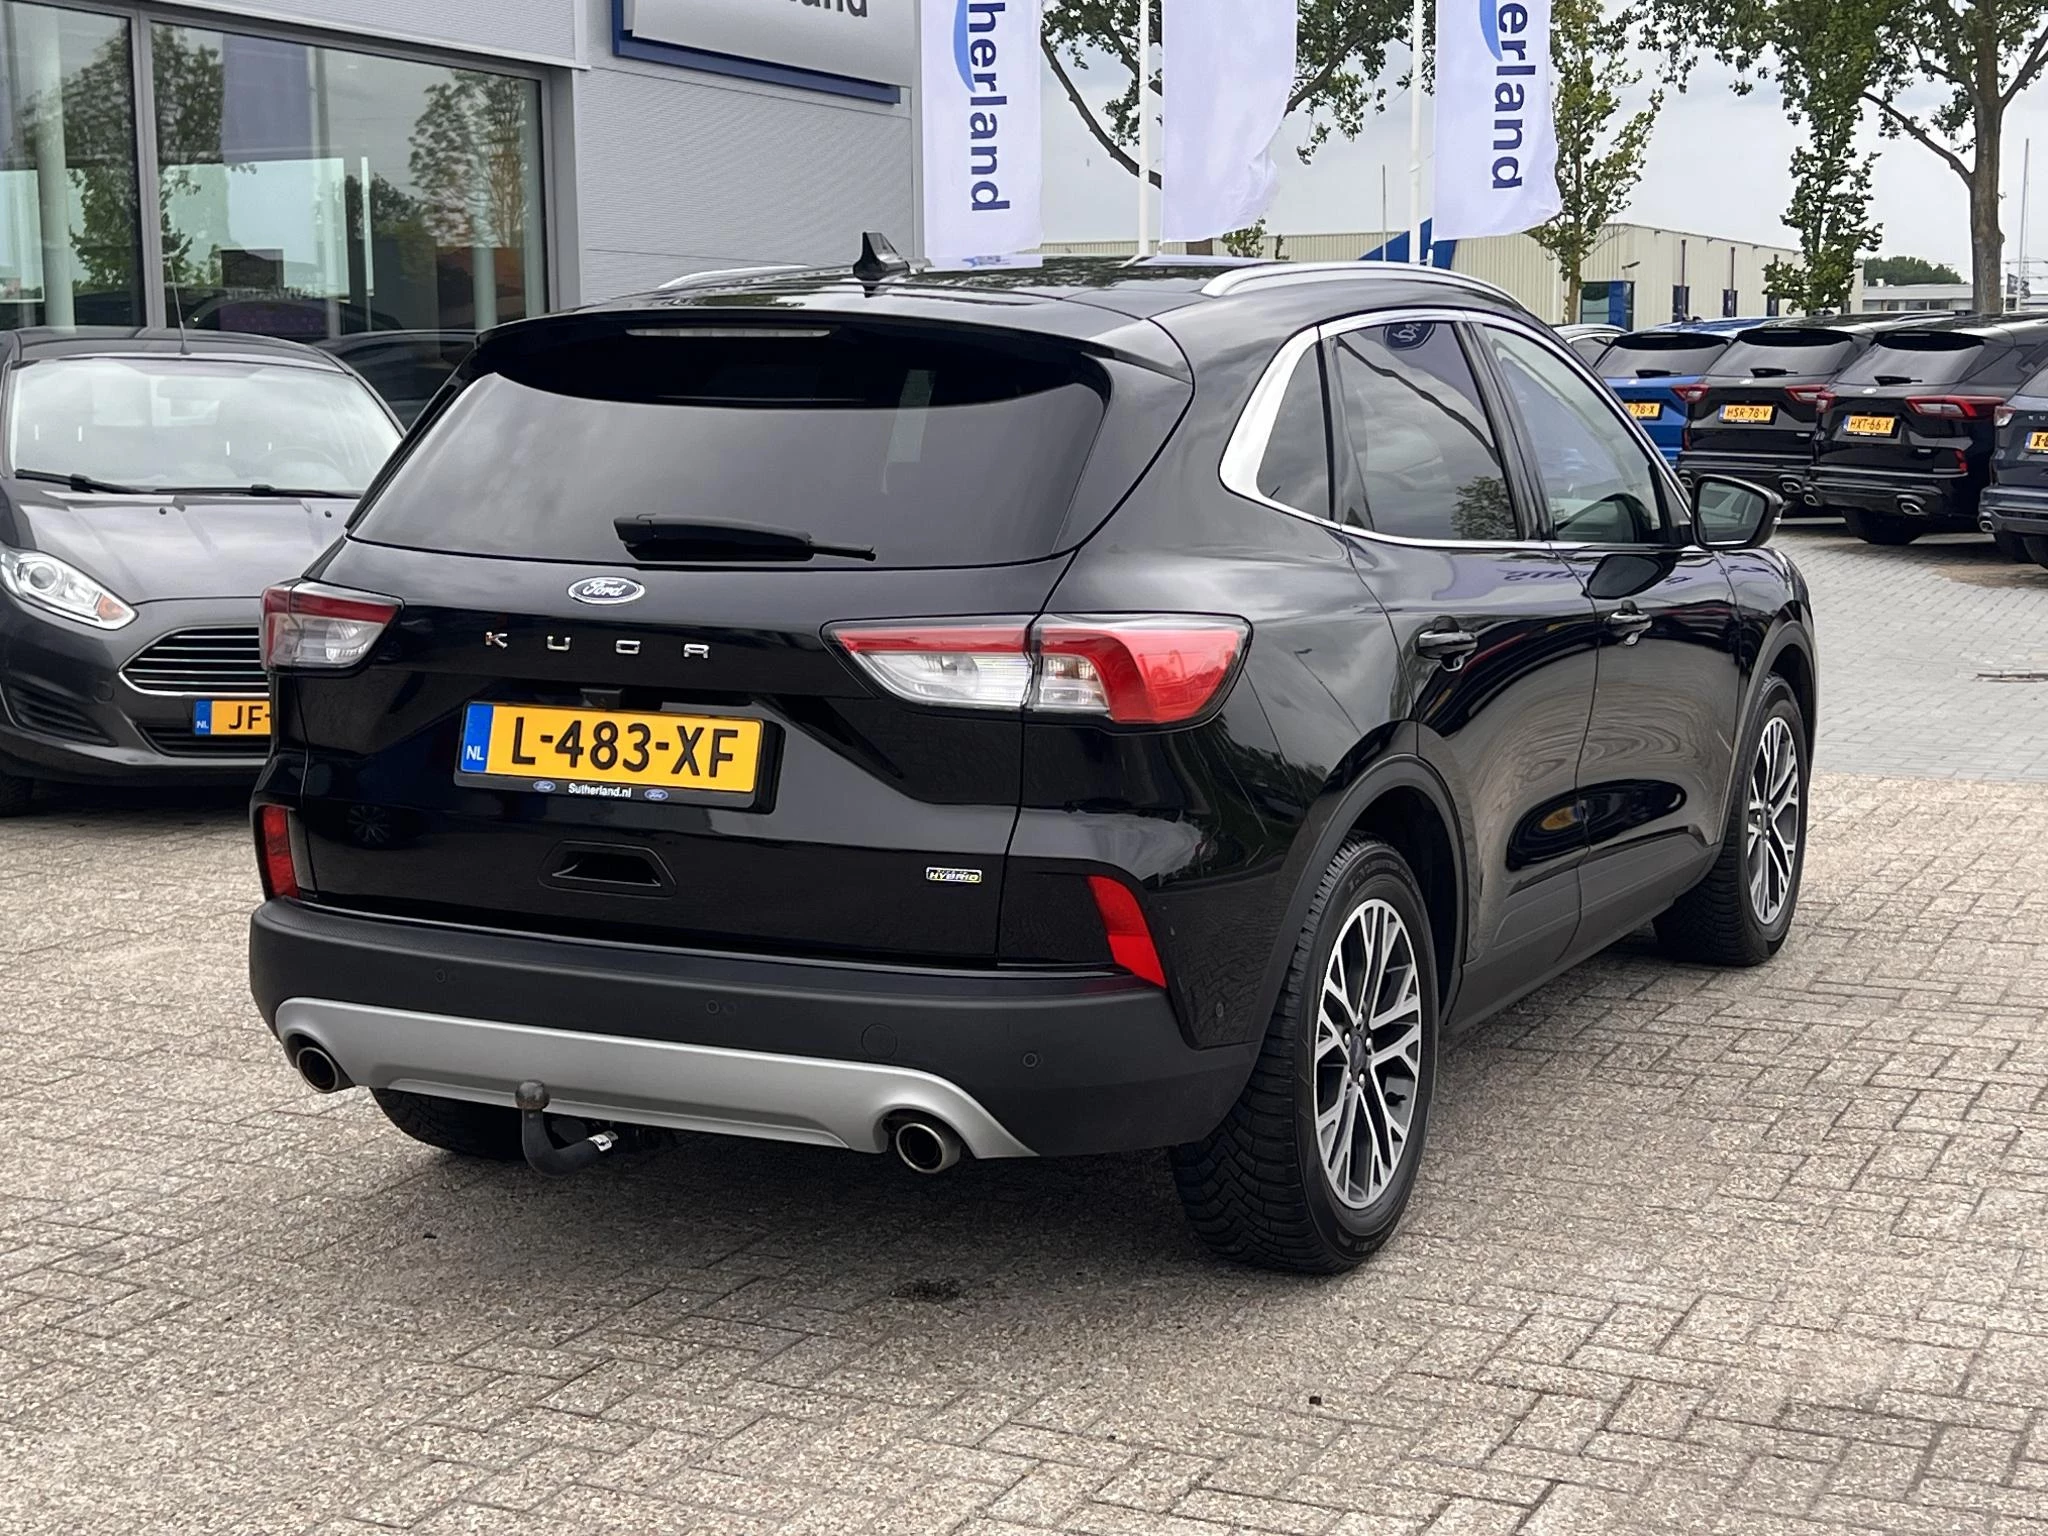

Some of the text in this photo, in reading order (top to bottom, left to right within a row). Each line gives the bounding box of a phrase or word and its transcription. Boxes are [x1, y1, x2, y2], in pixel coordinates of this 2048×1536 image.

[968, 2, 1011, 212] herland
[1491, 2, 1537, 190] erland
[581, 580, 628, 597] Ford
[485, 631, 710, 659] KUGA
[196, 719, 209, 729] NL
[465, 716, 739, 778] NL L-483-XF
[567, 782, 632, 798] Sutherland.nl
